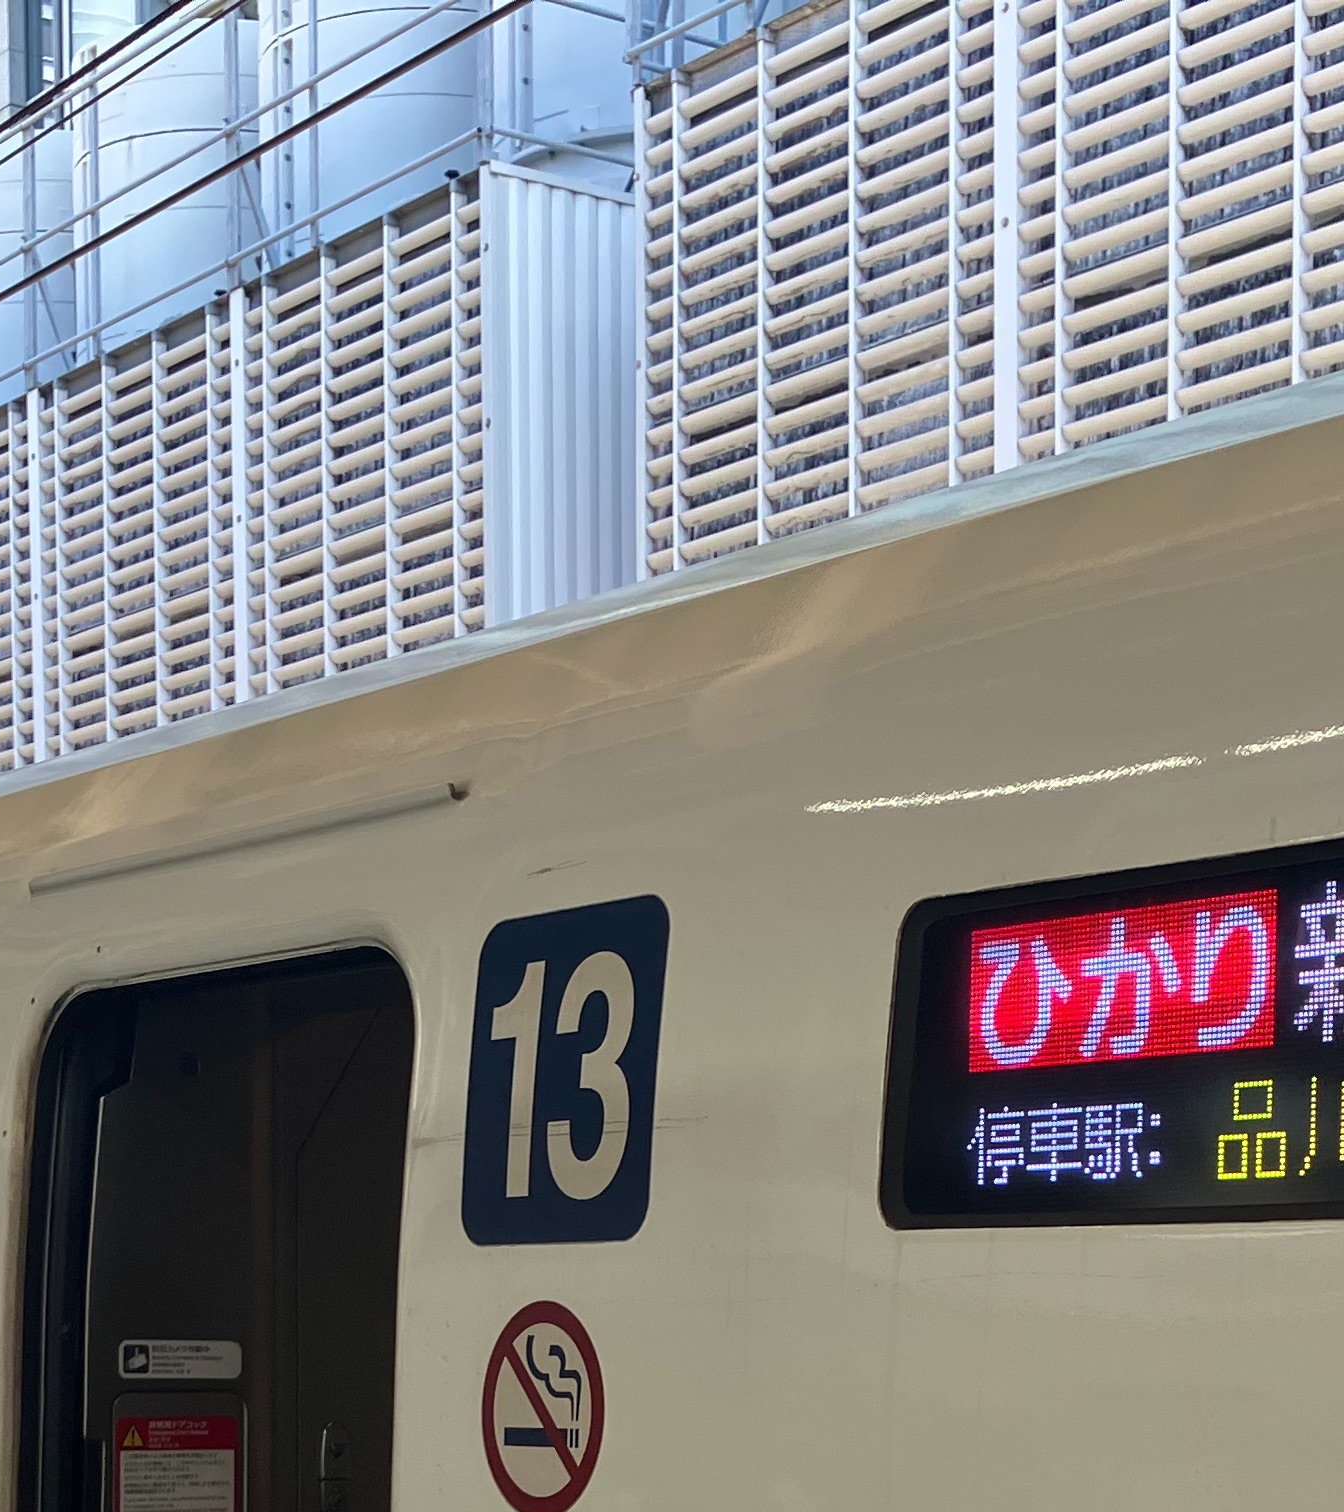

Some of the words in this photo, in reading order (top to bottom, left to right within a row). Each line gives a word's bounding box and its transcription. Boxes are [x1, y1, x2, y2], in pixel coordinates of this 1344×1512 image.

[491, 949, 635, 1200] 13
[978, 904, 1270, 1067] ひかり
